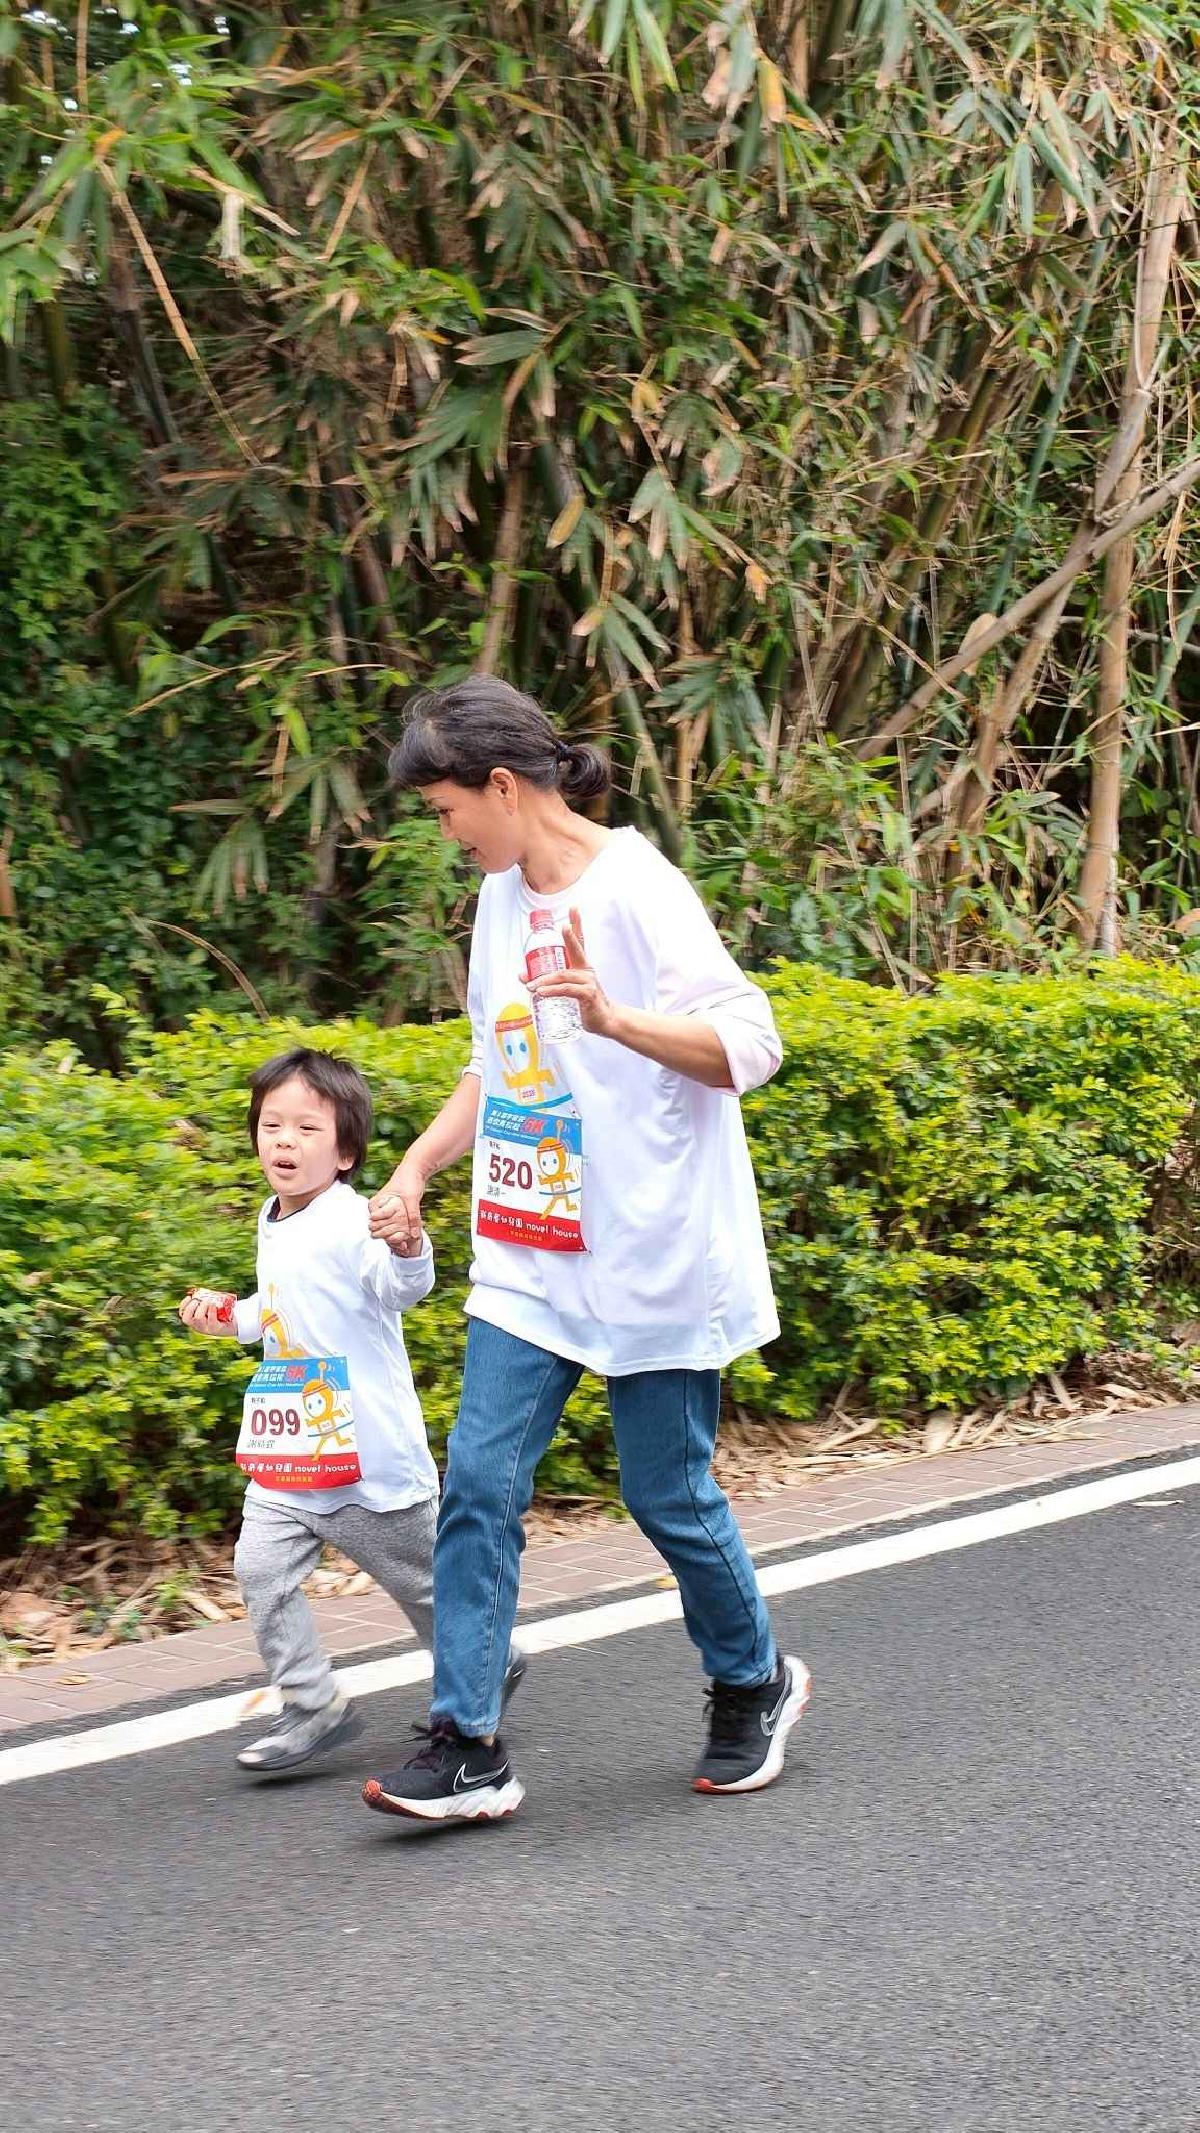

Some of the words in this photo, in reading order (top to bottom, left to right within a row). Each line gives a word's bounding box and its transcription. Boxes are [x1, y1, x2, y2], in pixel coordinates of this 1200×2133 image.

[489, 1153, 532, 1190] 520
[526, 1223, 549, 1234] novel
[552, 1225, 579, 1239] house
[251, 1408, 300, 1436] 099
[295, 1463, 320, 1473] novel
[325, 1464, 356, 1473] house
